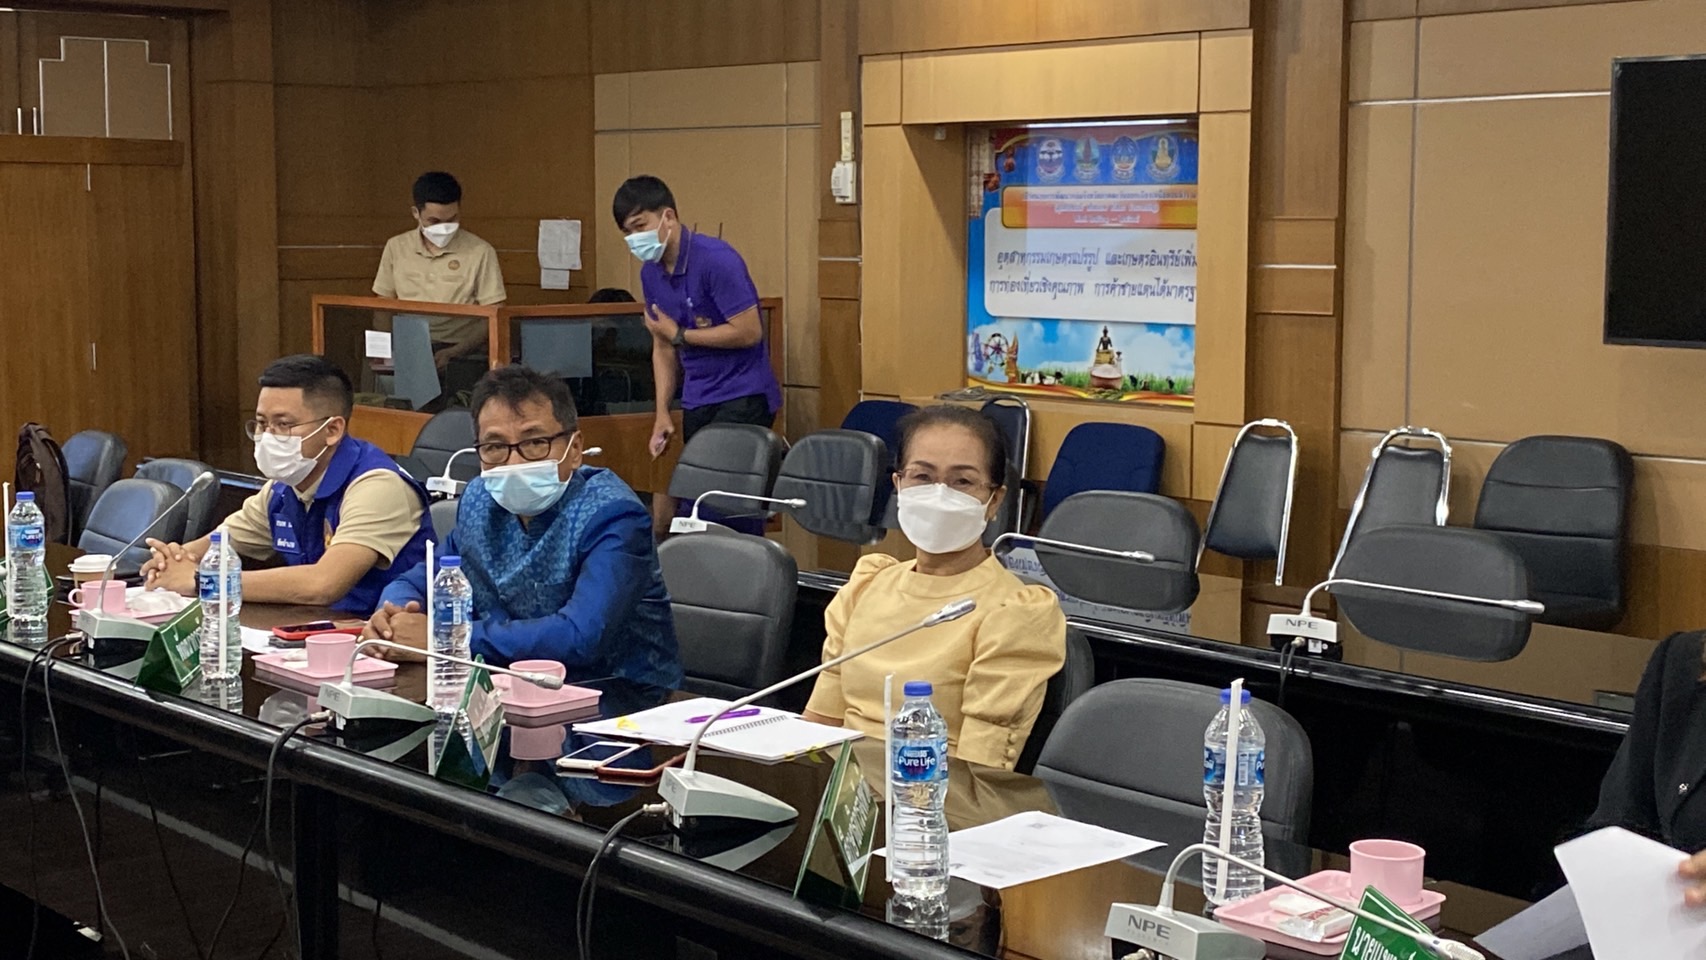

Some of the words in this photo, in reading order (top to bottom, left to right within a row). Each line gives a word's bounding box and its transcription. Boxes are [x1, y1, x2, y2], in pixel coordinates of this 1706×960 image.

[1285, 618, 1319, 630] NPE
[899, 756, 919, 767] Pure
[920, 756, 936, 770] Life
[1127, 914, 1172, 940] NPE
